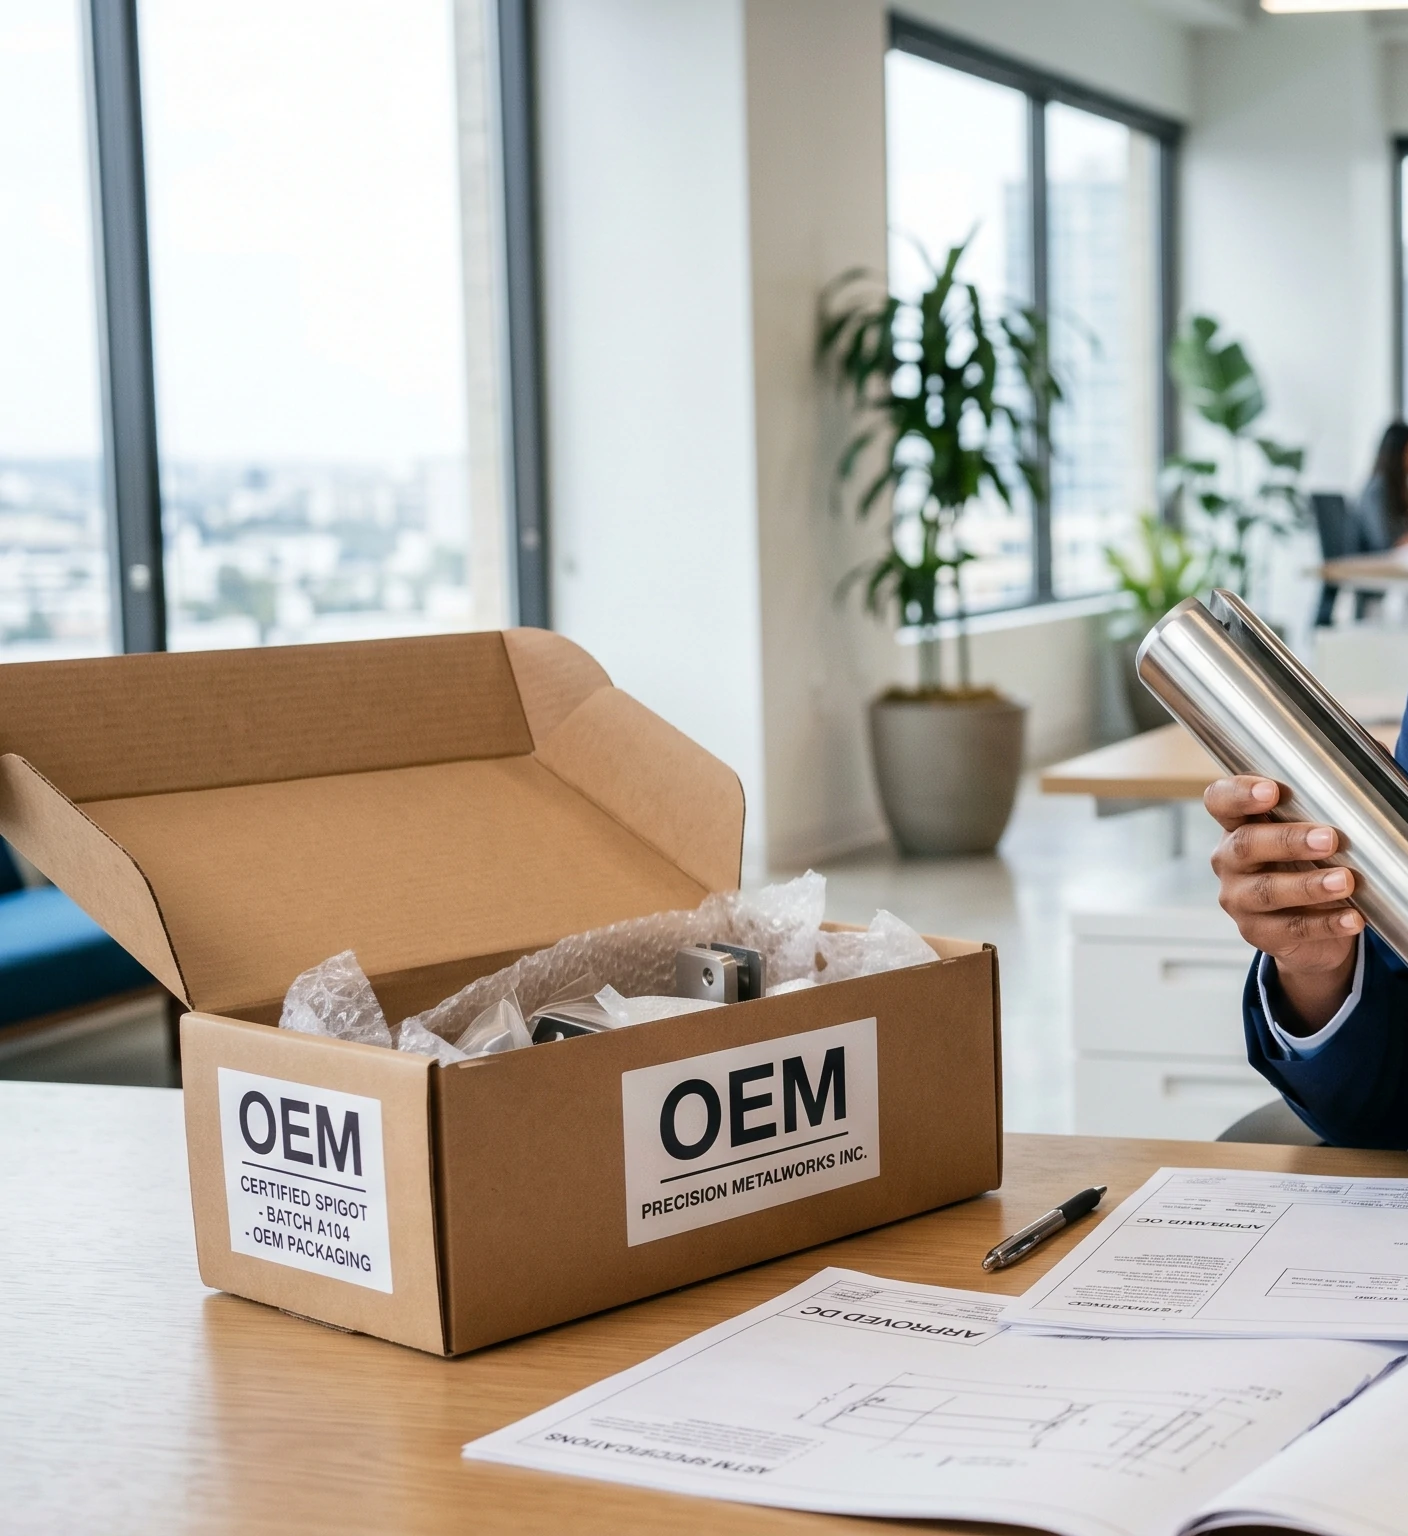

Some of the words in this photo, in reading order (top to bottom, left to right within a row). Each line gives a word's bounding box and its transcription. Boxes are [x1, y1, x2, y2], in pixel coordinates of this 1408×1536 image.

[659, 1046, 846, 1160] OEM
[239, 1090, 362, 1177] OEM
[240, 1175, 311, 1207] CERTIFIED
[315, 1193, 367, 1221] SPIGOT
[642, 1182, 727, 1219] PRECISION
[732, 1153, 835, 1194] METALWORKS
[839, 1145, 867, 1165] INC.
[266, 1205, 313, 1233] BATCH
[317, 1219, 351, 1242] A104
[253, 1226, 284, 1250] OEM
[287, 1235, 372, 1272] PACKAGING
[799, 1306, 843, 1319] DC
[711, 1459, 772, 1475] ASTM
